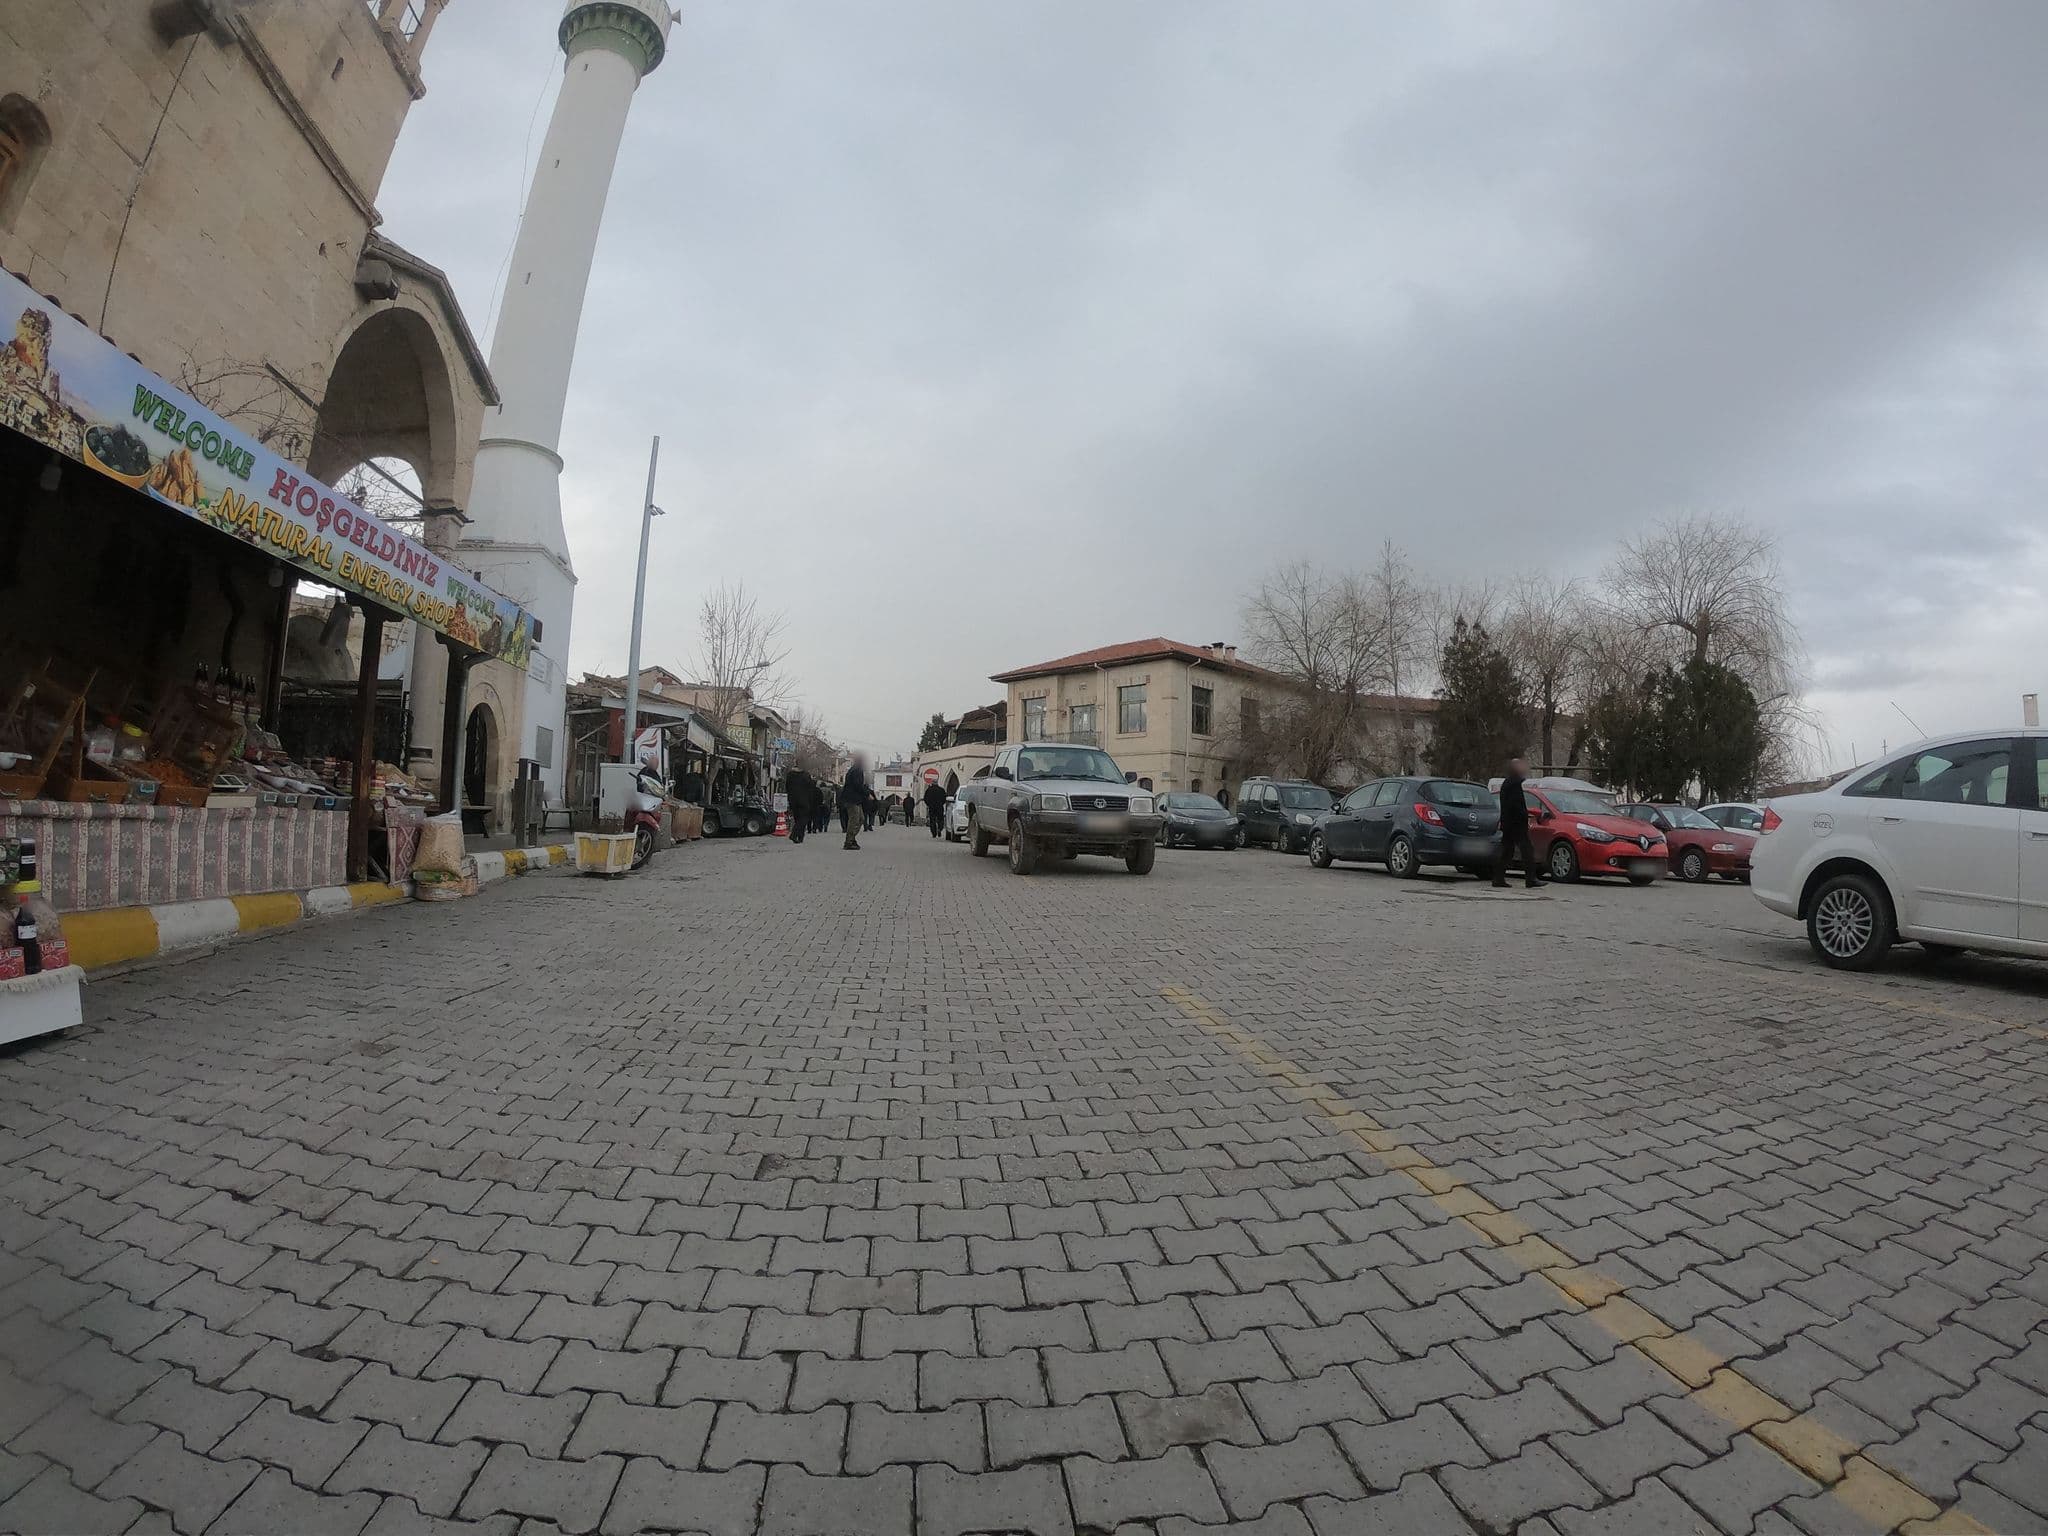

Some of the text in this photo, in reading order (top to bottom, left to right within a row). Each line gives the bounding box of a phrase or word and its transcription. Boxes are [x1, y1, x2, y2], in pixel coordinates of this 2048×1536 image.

[132, 384, 440, 588] WELCOME HOŞGELDİNİZ
[217, 487, 456, 626] NATURAL ENERGY SHOP
[447, 576, 496, 618] WELCOME
[0, 951, 10, 960] EA
[40, 942, 54, 952] TEA
